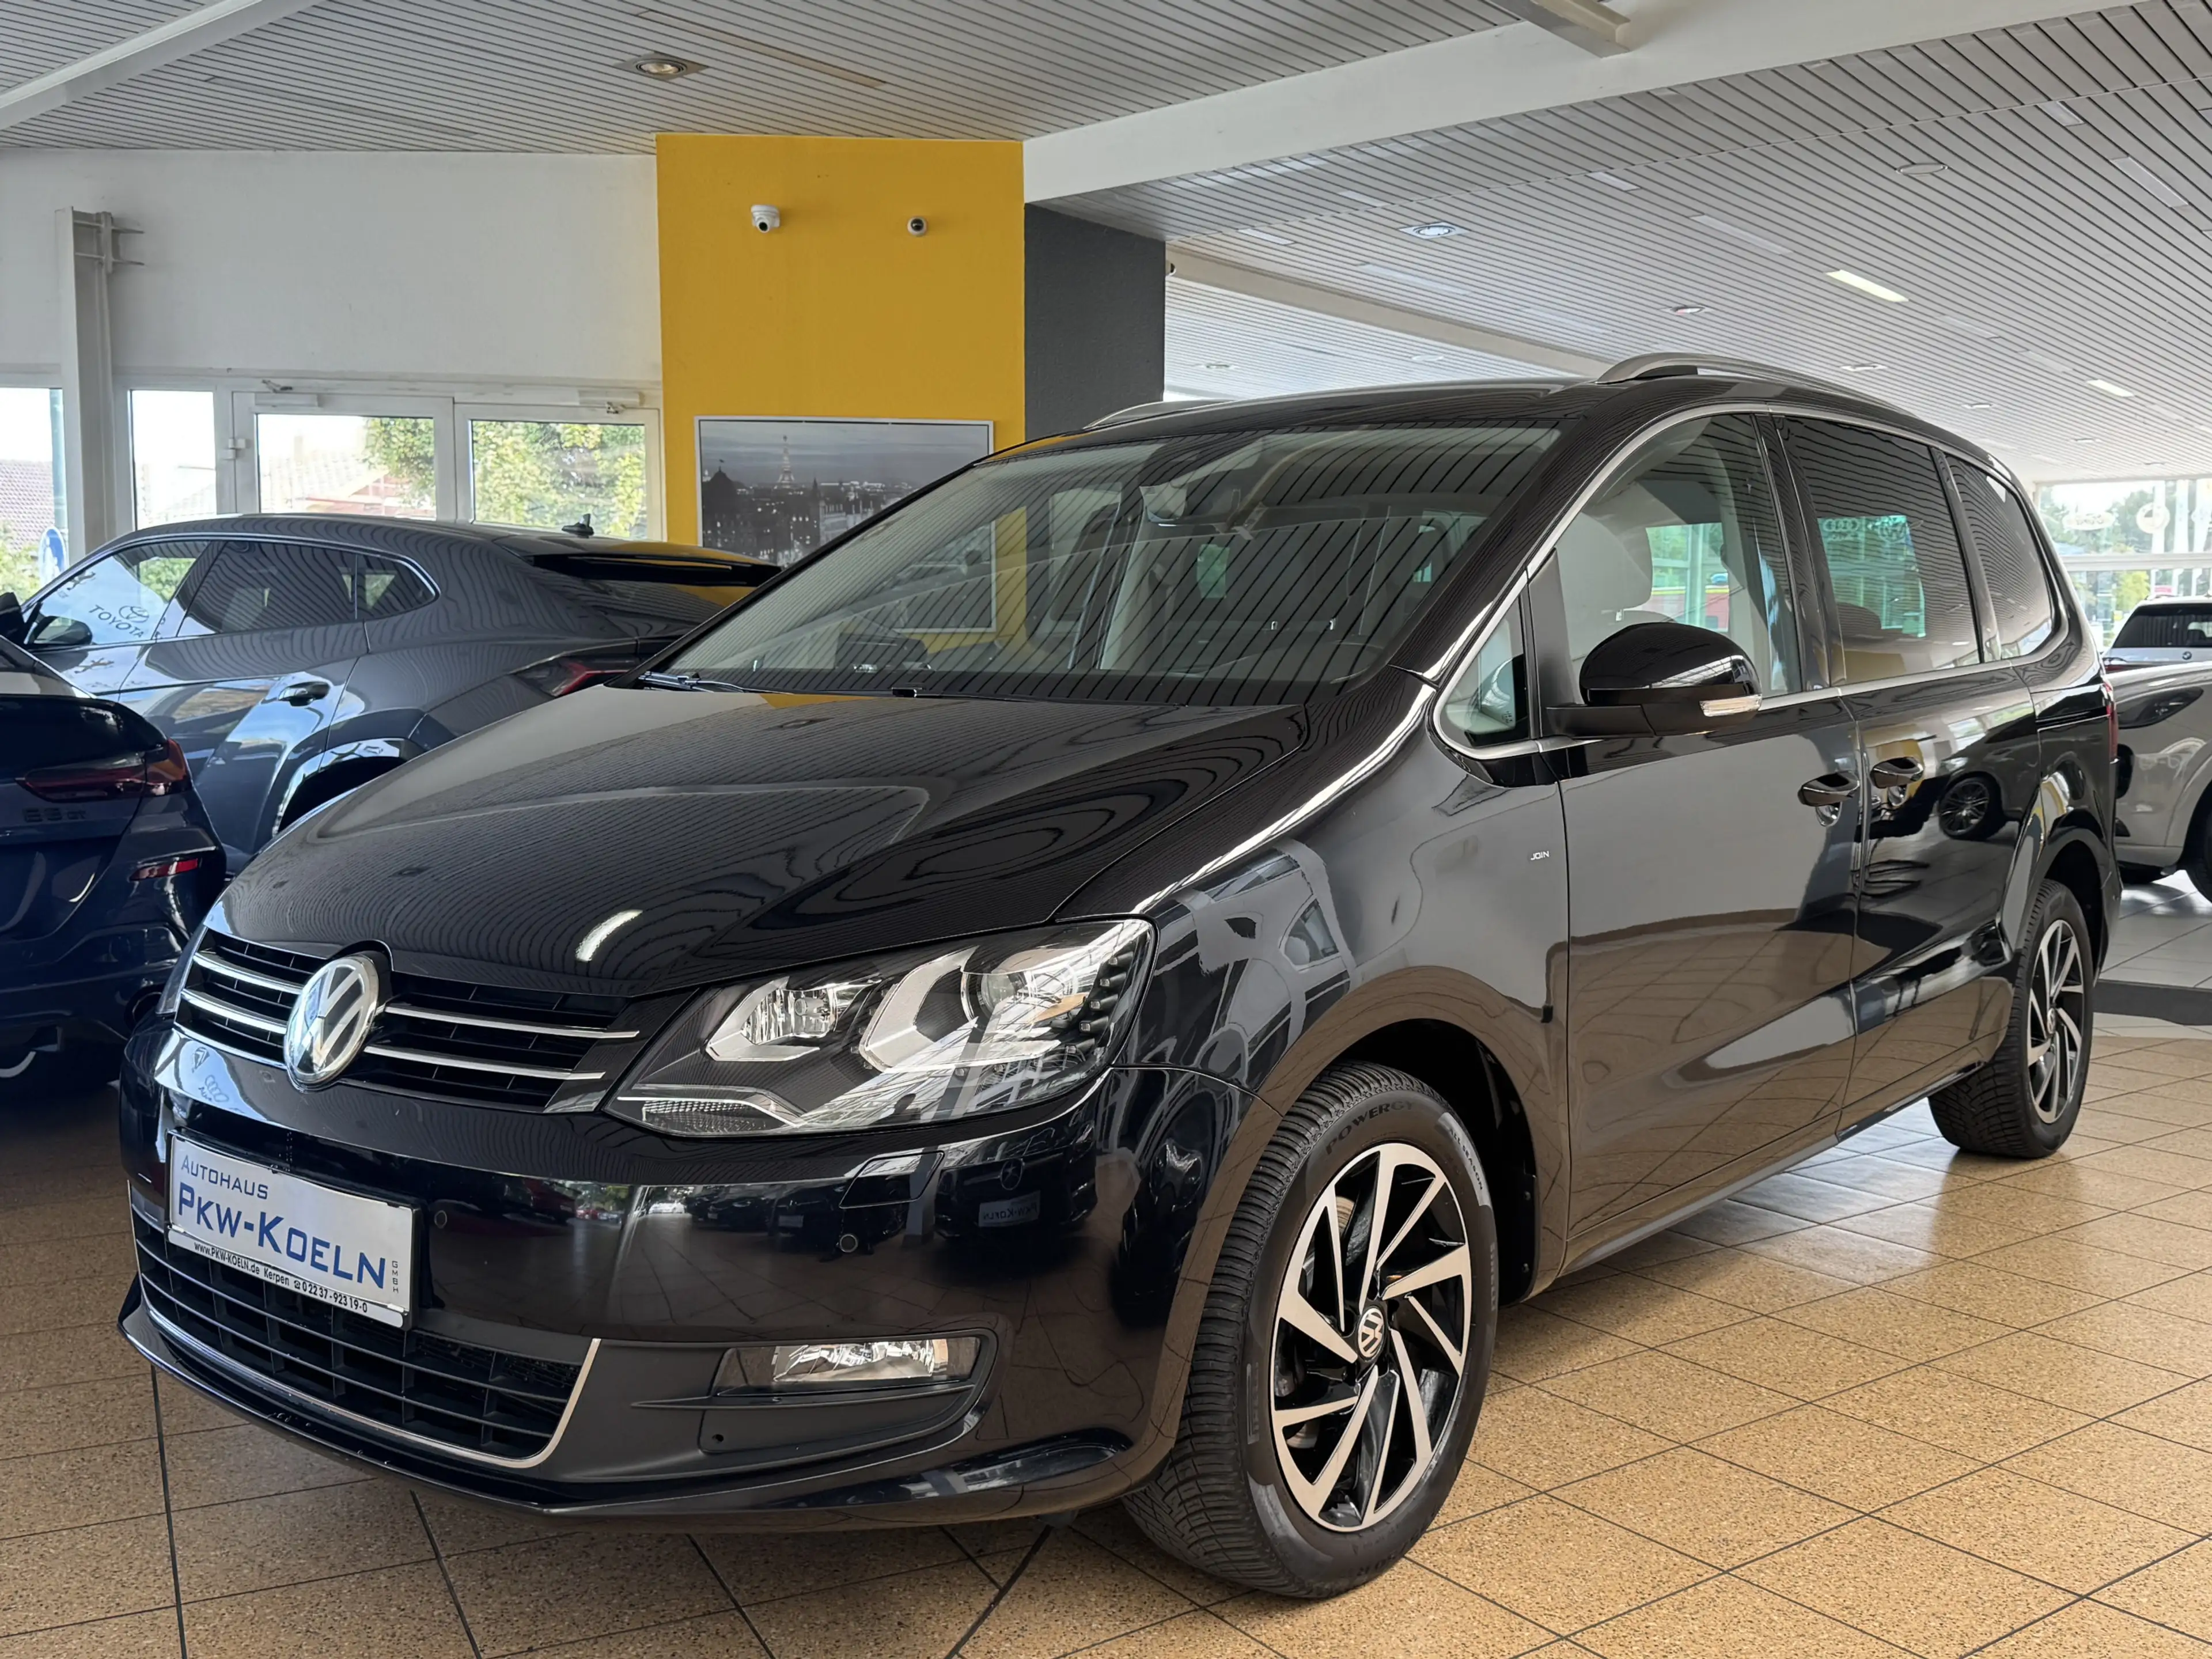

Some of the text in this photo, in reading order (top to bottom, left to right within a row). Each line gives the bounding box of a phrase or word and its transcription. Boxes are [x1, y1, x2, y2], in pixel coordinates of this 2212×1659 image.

[1530, 850, 1550, 861] JOIN
[1325, 1100, 1415, 1155] POWERGY
[180, 1155, 269, 1200] AUTOHAUS
[179, 1181, 386, 1290] PKW-KOELN
[263, 1267, 290, 1286] Kerpen
